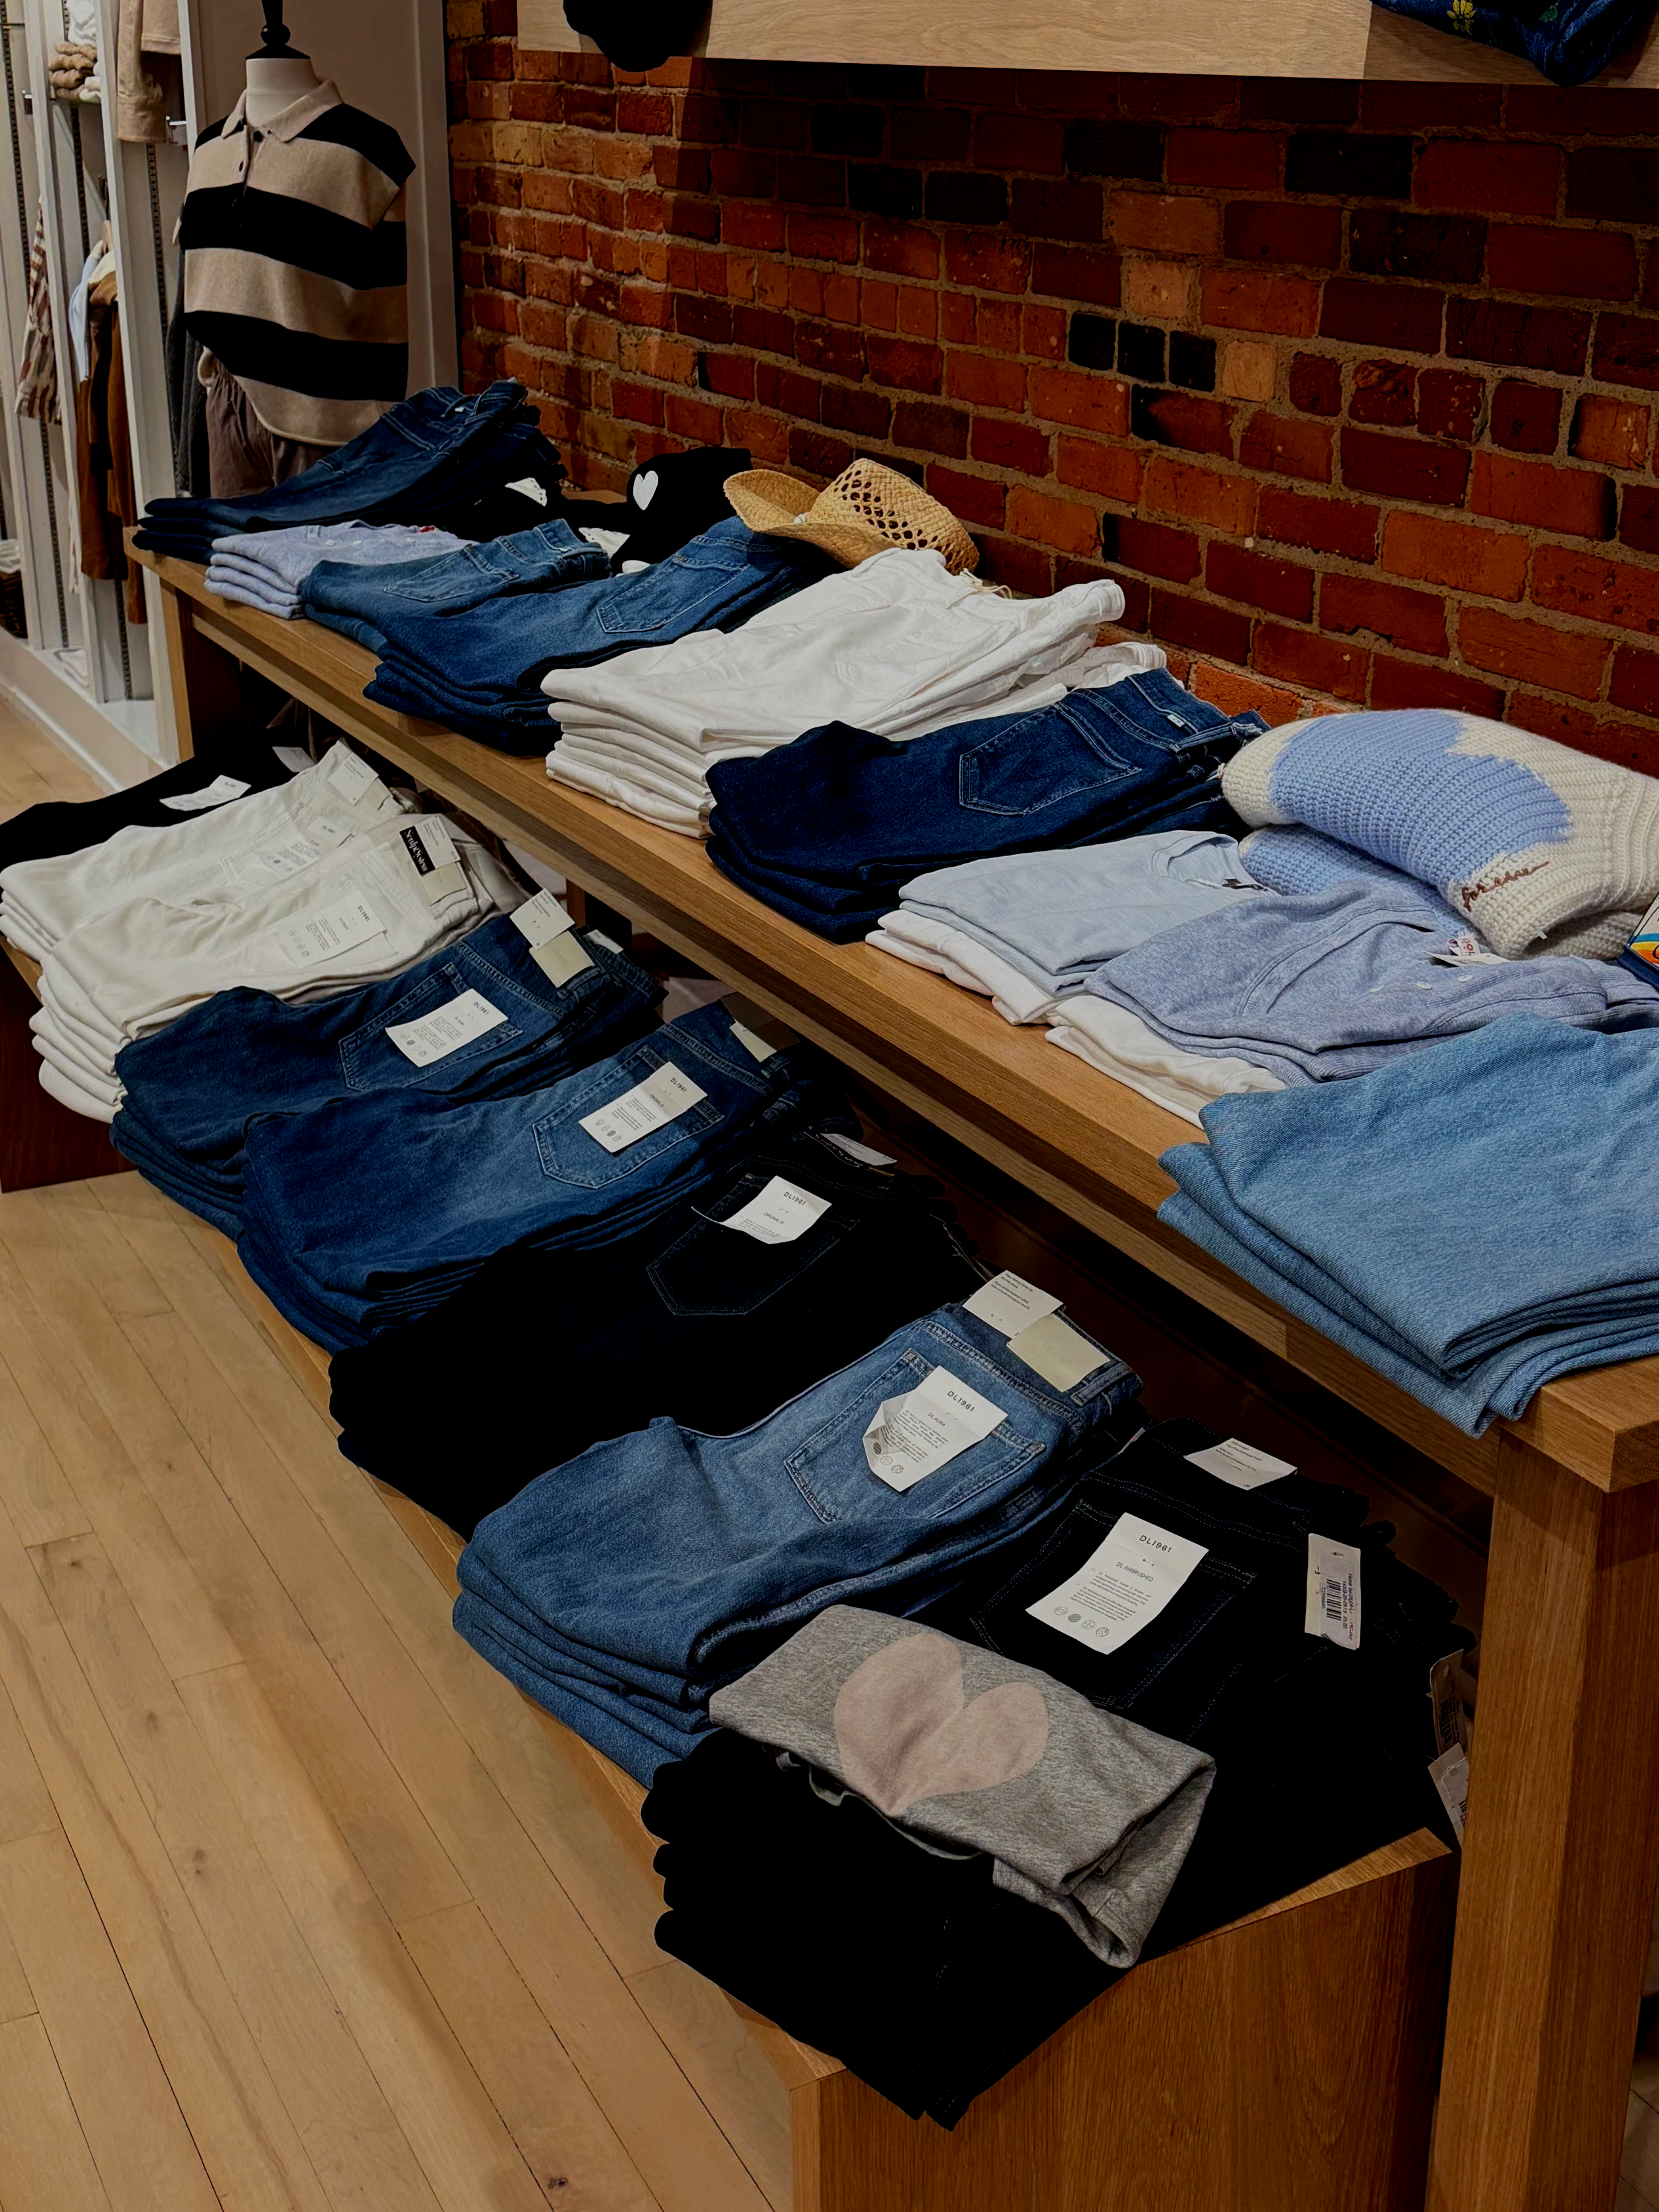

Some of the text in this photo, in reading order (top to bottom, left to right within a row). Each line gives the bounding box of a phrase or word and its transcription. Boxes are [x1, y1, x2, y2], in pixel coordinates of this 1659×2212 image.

[784, 1192, 806, 1206] DL1961
[947, 1391, 975, 1412] DL1961
[1139, 1535, 1172, 1553] DL1961
[1123, 1565, 1154, 1582] AIRBRUSHED
